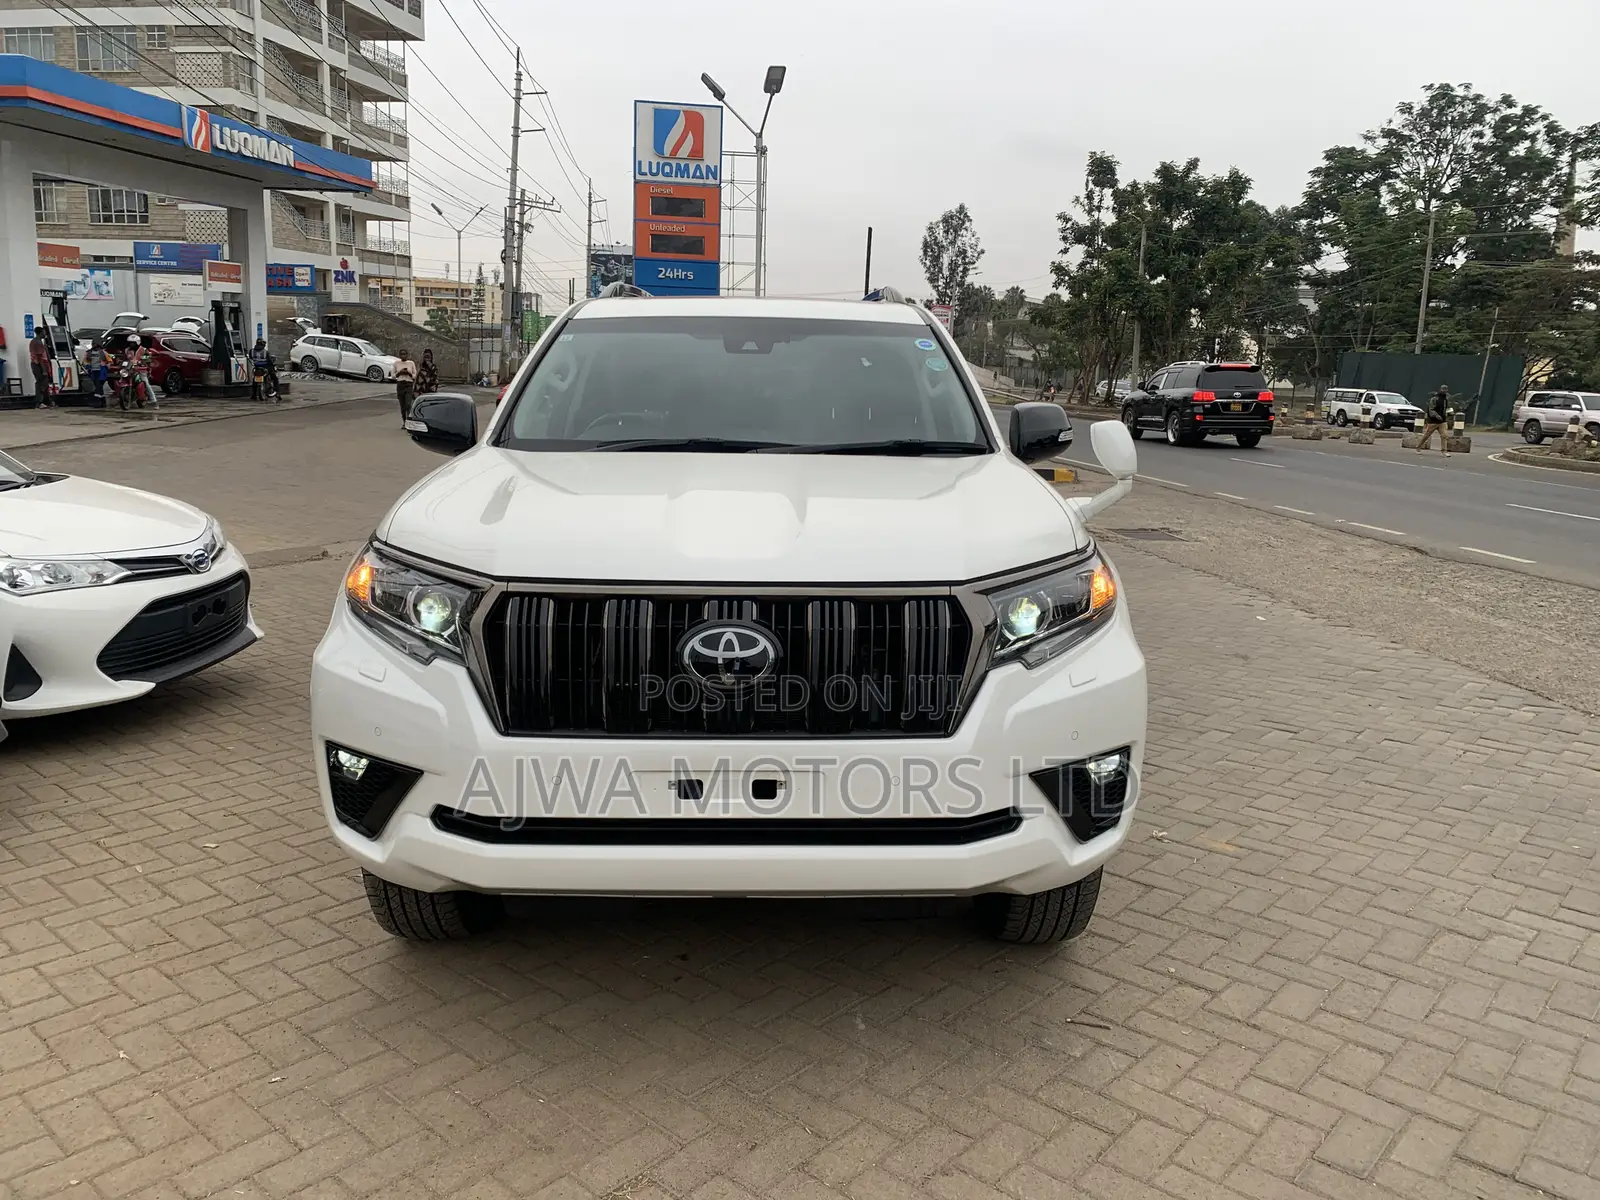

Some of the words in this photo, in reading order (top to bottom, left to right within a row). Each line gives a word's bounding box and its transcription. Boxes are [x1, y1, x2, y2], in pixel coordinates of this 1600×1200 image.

[211, 123, 295, 168] LUQMAN
[637, 160, 719, 180] LUQMAN
[650, 186, 674, 195] Diesel
[650, 223, 686, 233] Unleaded
[333, 270, 357, 285] ZNK
[657, 267, 694, 281] 24Hrs
